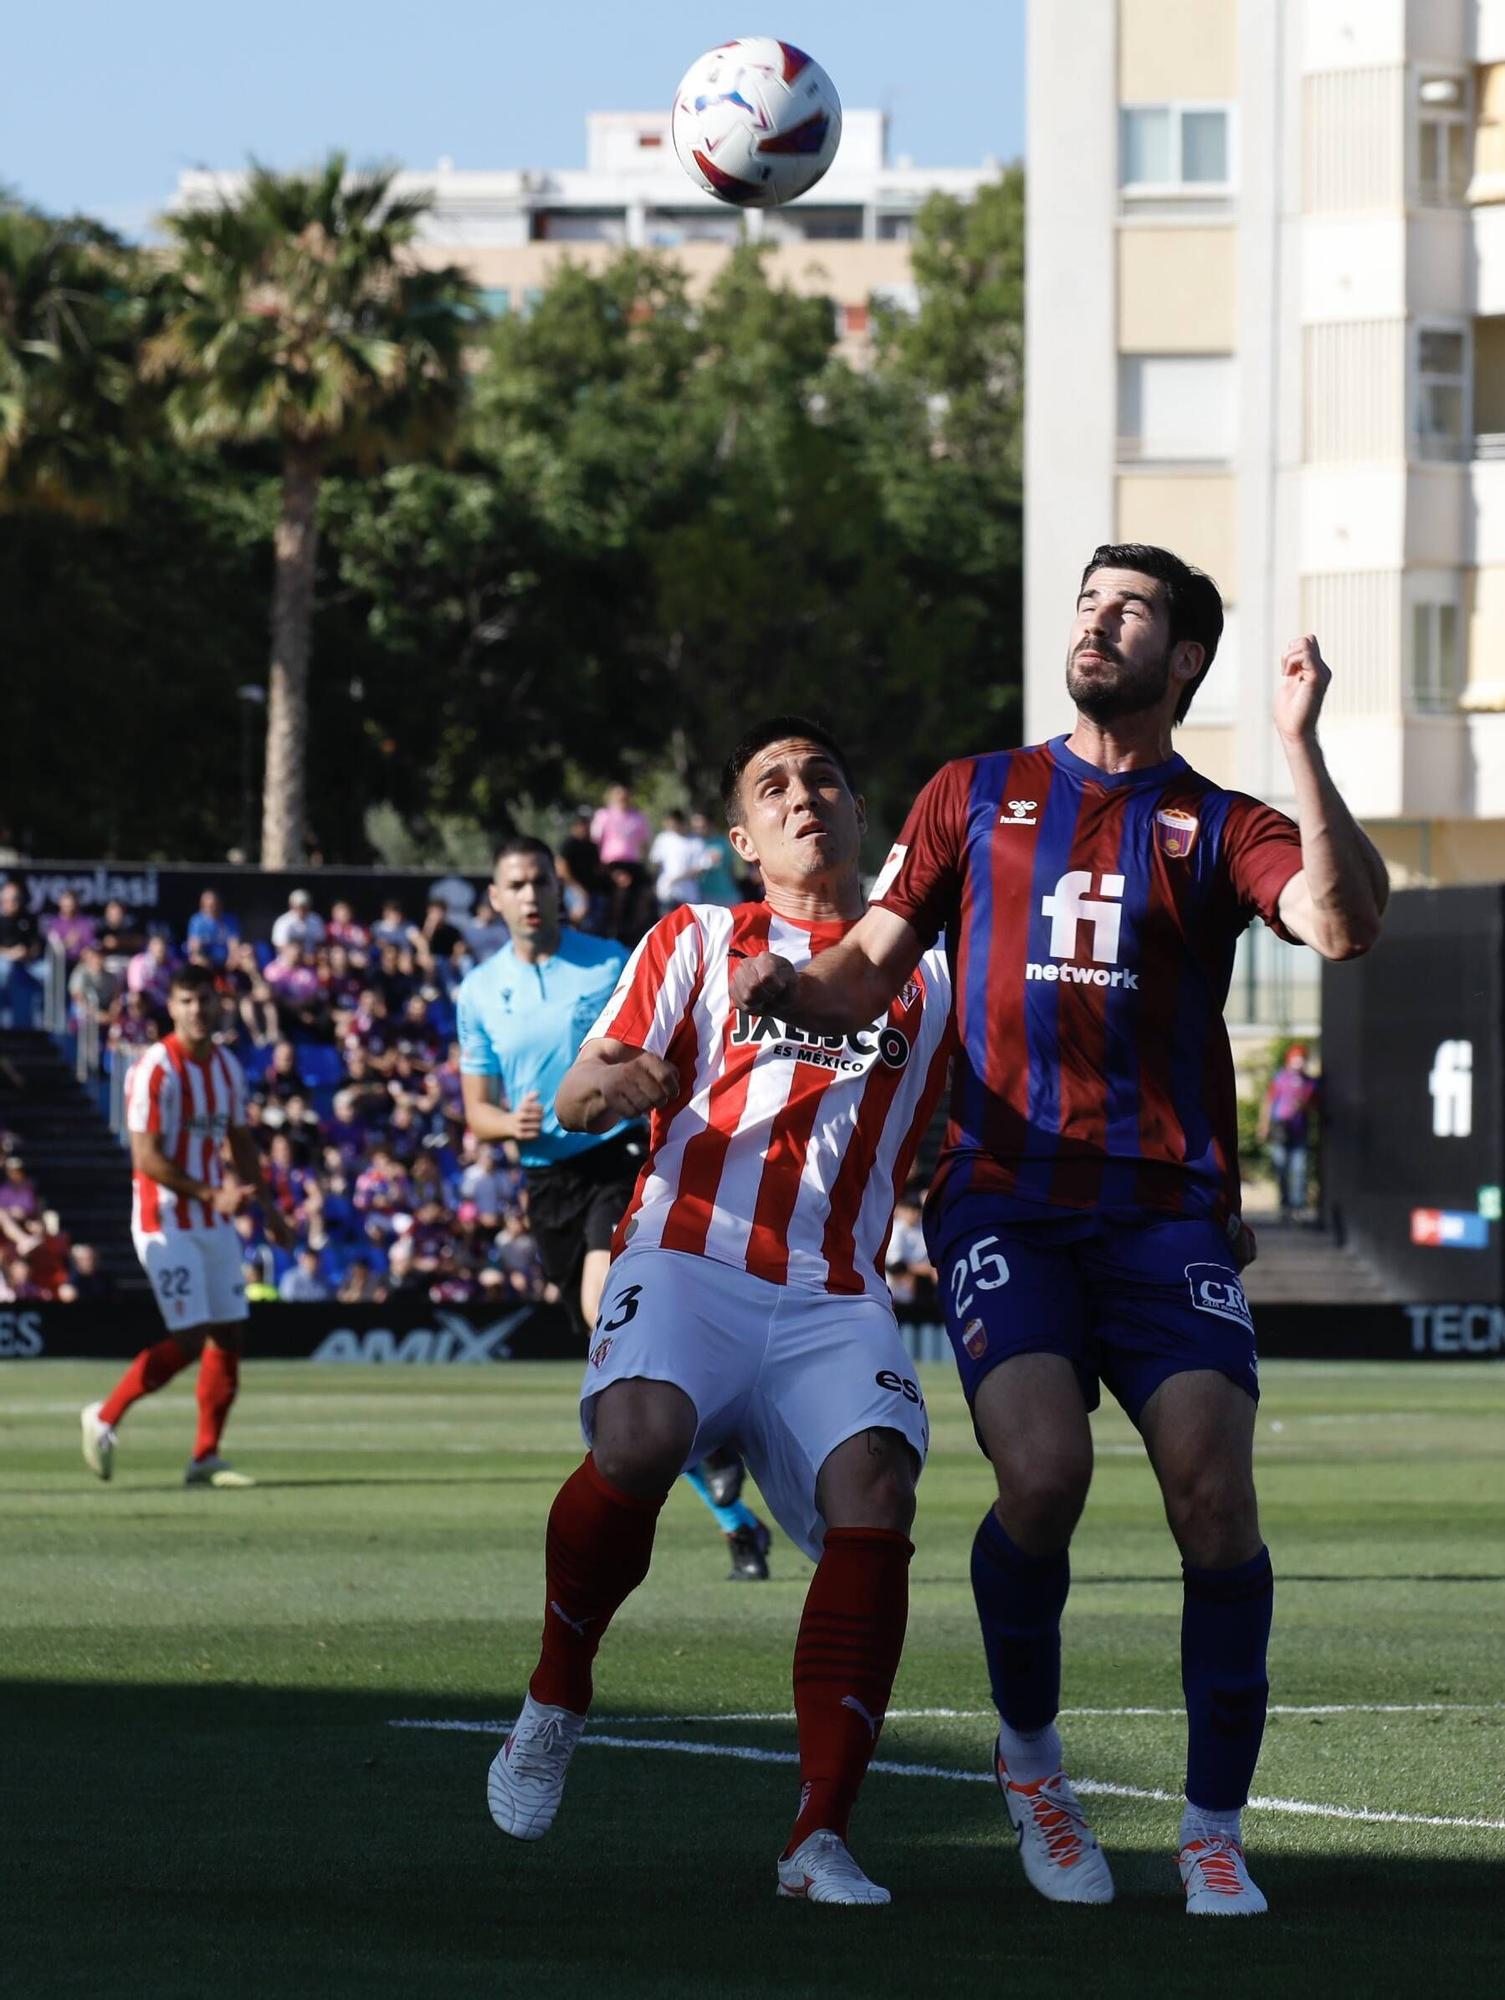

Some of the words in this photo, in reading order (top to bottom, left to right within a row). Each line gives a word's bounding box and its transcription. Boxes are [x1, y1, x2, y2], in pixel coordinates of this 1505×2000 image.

[1041, 870, 1125, 964] fi
[1025, 962, 1139, 990] network
[773, 1044, 793, 1057] ES
[797, 1047, 864, 1073] MÉXICO
[1429, 1040, 1472, 1137] fi
[159, 1267, 190, 1298] 22
[951, 1235, 1010, 1318] 25
[596, 1285, 644, 1332] 3
[311, 1305, 534, 1363] AMIX
[875, 1370, 925, 1411] es
